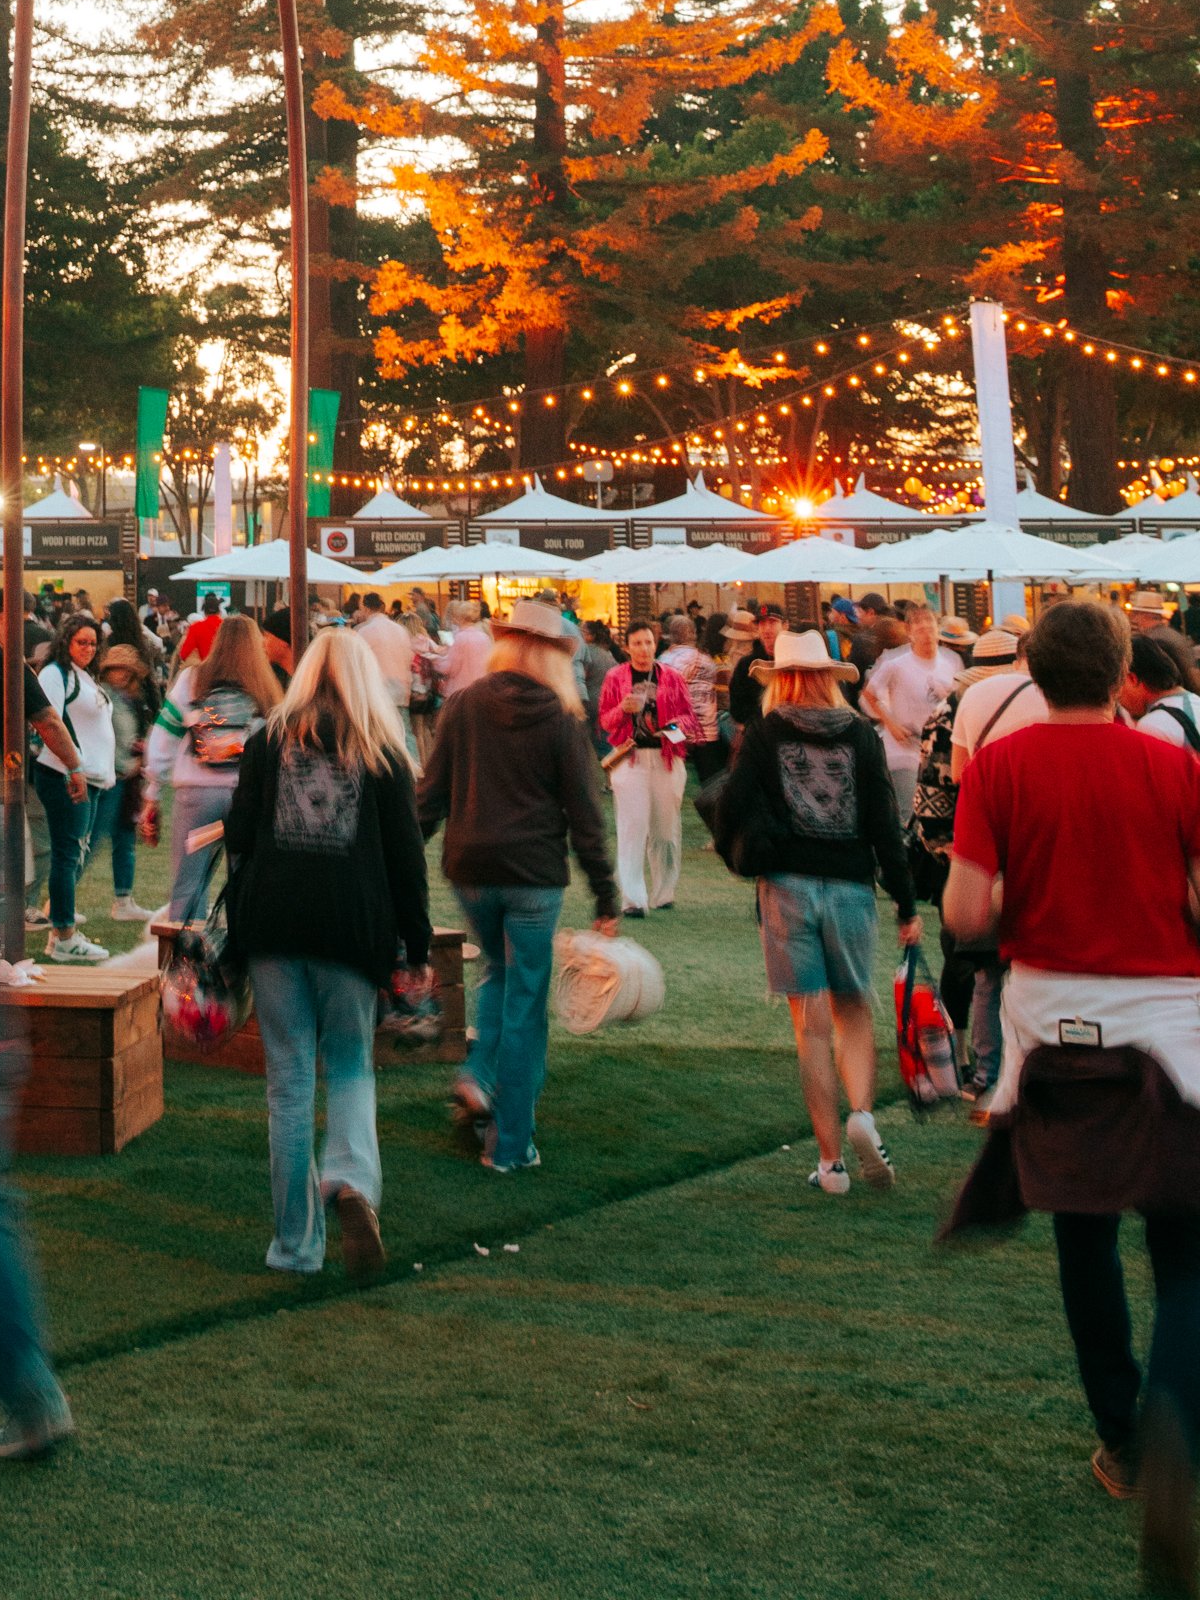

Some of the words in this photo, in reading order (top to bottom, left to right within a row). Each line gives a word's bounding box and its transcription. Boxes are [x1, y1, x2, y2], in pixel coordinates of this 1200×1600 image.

[42, 536, 63, 547] WOOD
[64, 536, 86, 546] FIRED
[87, 536, 108, 546] PIZZA
[371, 531, 393, 541] FRIED
[394, 531, 426, 542] CHICKEN
[691, 531, 724, 542] OAXACAN
[725, 531, 749, 542] SMALL
[750, 531, 771, 542] BITES
[866, 532, 899, 543] CHICKEN
[1069, 532, 1099, 542] CUISINE
[375, 543, 422, 553] SANDWICHES
[543, 538, 564, 549] SOUL
[564, 538, 584, 549] FOOD
